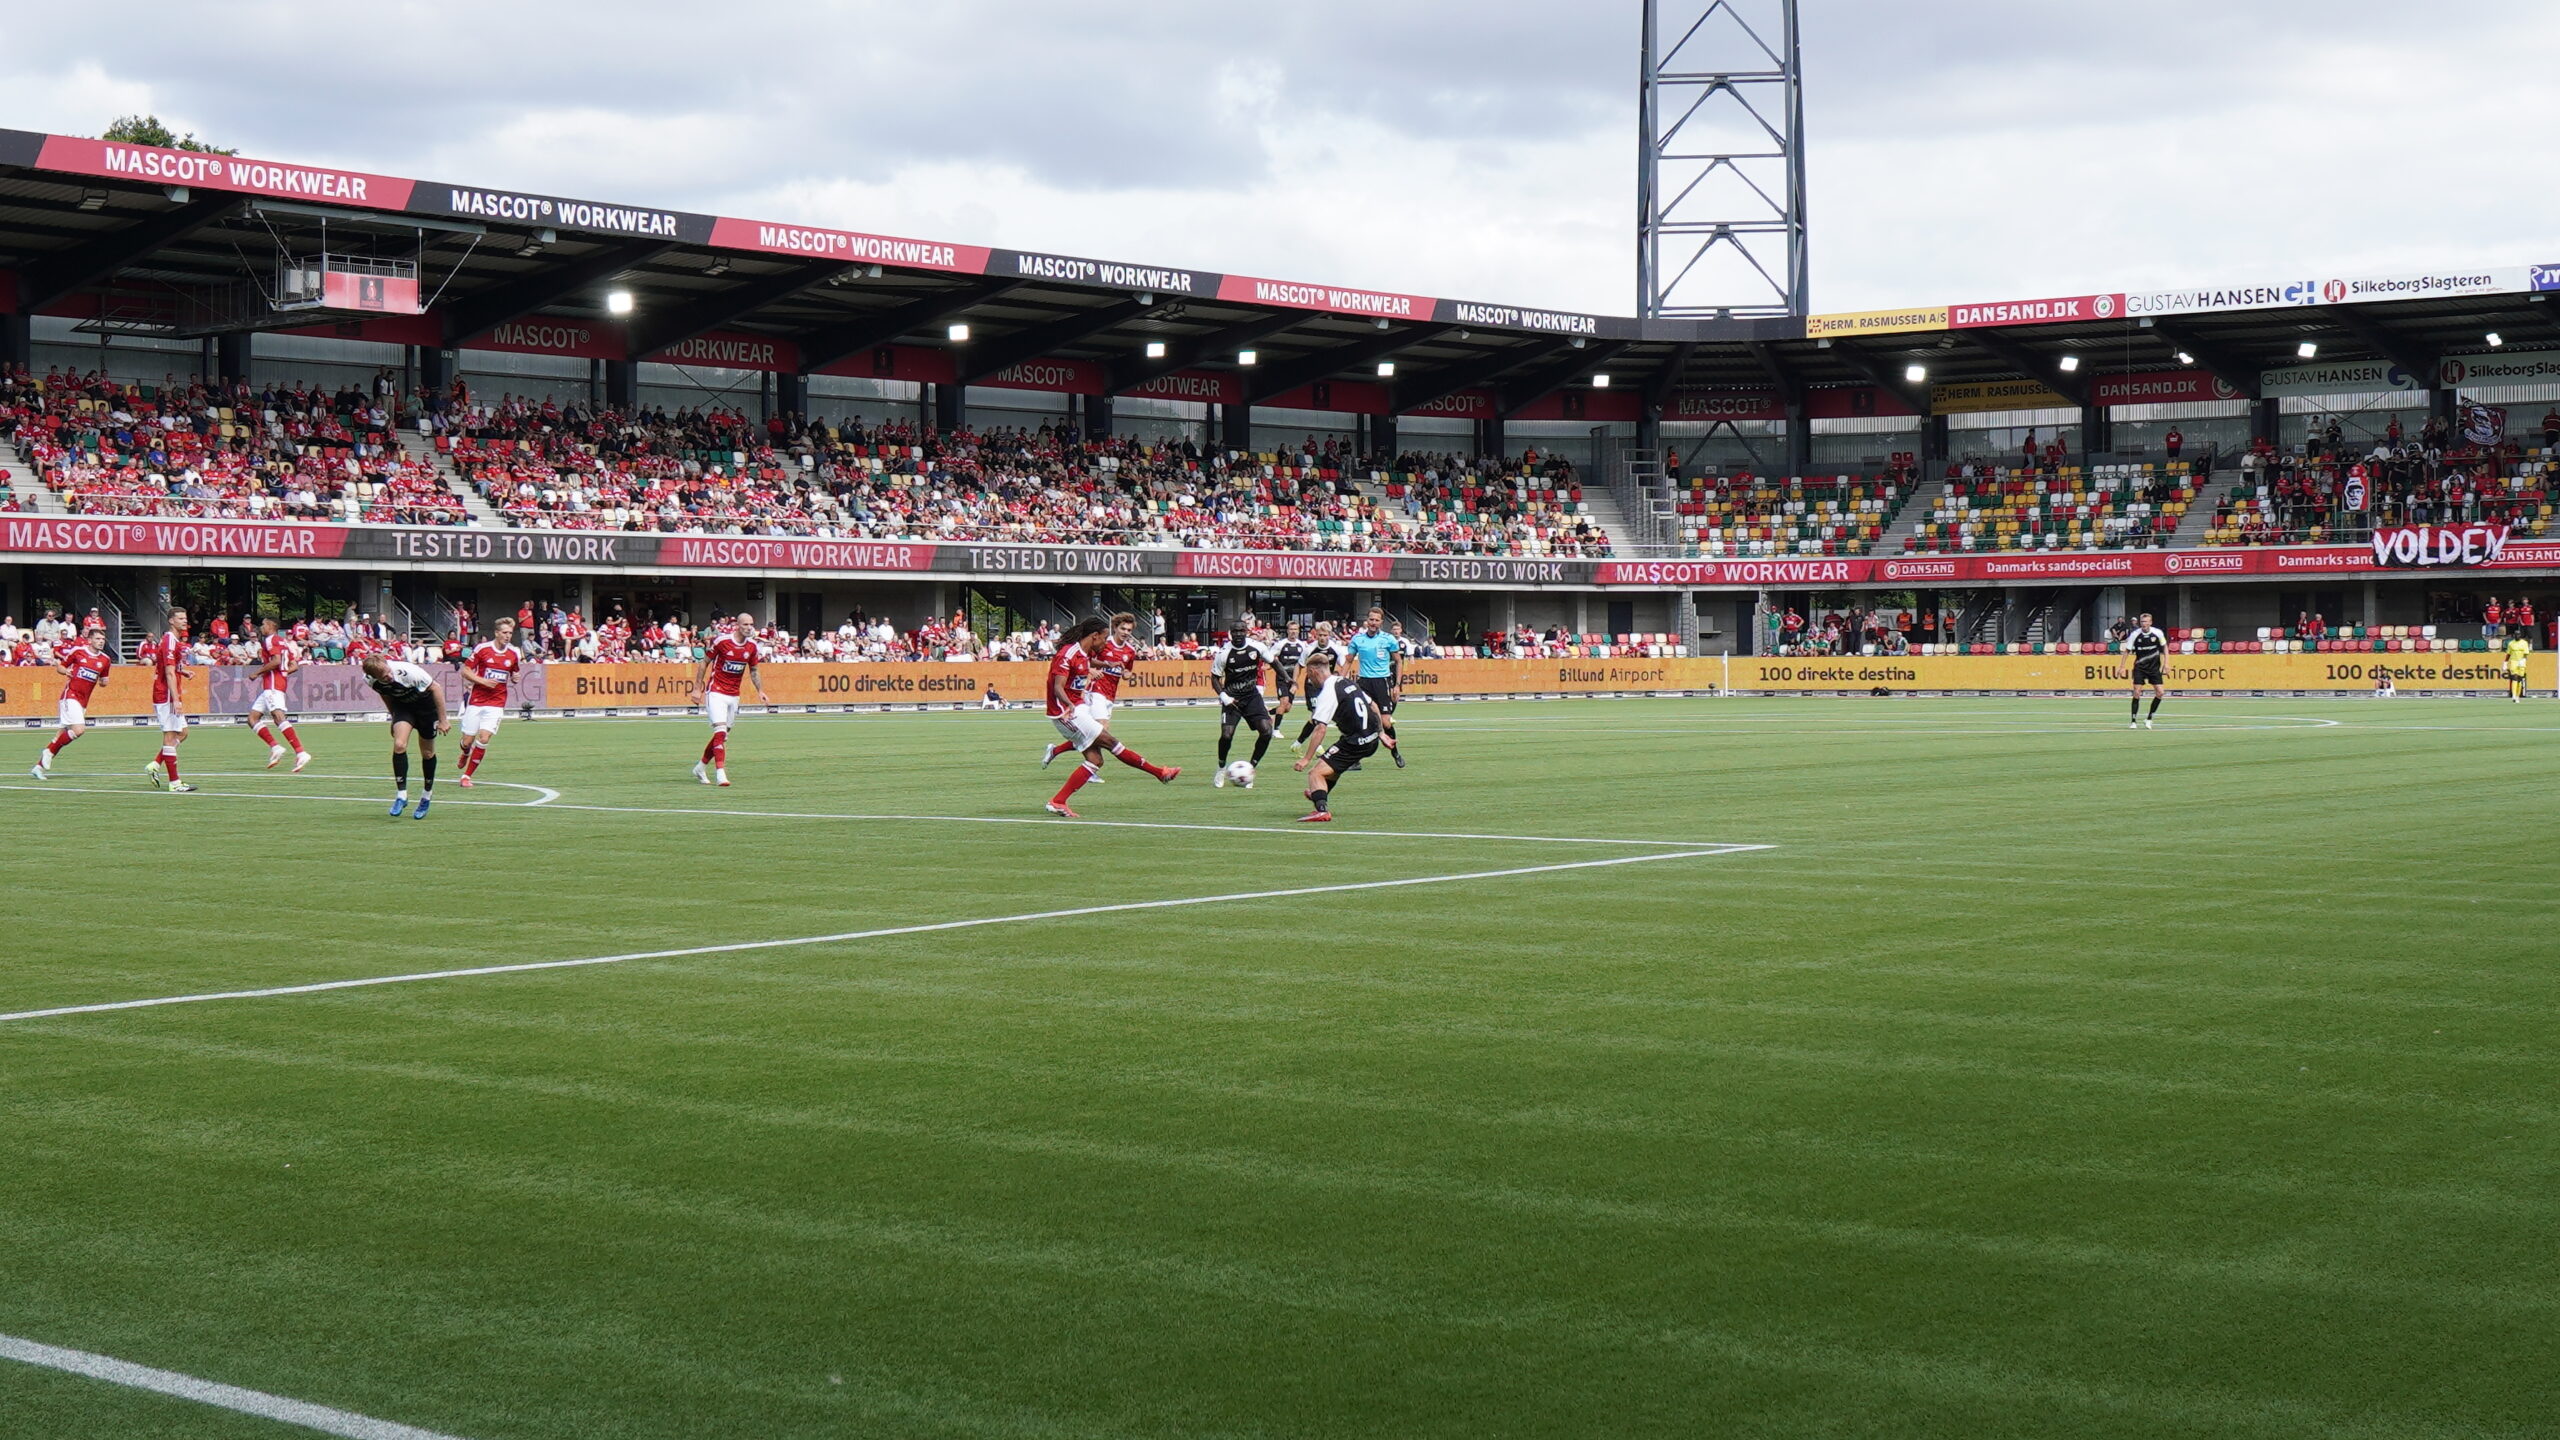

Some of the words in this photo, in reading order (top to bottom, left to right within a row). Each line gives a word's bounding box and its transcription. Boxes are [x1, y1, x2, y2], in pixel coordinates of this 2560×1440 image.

[229, 163, 367, 200] WORKWEAR
[558, 202, 677, 237] WORKWEAR
[852, 236, 955, 267] WORKWEAR
[1099, 263, 1191, 291] WORKWEAR
[2351, 273, 2492, 295] SilkeborgSlagteren
[1329, 290, 1411, 315] WORKWEAR
[2126, 287, 2281, 314] GUSTAVHANSEN
[1521, 311, 1596, 334] WORKWEAR
[1823, 317, 1858, 330] HERM.
[1860, 314, 1926, 328] RASMUSSEN
[1928, 312, 1947, 325] A/S
[1956, 301, 2080, 324] DANSAND.DK
[664, 339, 774, 364] WORKWEAR
[2261, 368, 2382, 387] GUSTAVHANSEN
[1948, 387, 1984, 399] HERM.
[2100, 380, 2198, 397] DANSAND.DK
[155, 525, 316, 555] WORKWEAR
[392, 532, 492, 558] TESTED
[502, 534, 534, 560] TO
[543, 535, 617, 562] WORK
[791, 543, 912, 568] WORKWEAR
[969, 548, 1046, 571] TESTED
[1054, 550, 1077, 571] TO
[1086, 551, 1142, 573] WORK
[1986, 561, 2045, 574] Danmarks
[2048, 558, 2131, 574] sandspecialist
[2184, 556, 2242, 569] DANSAND
[2278, 553, 2341, 568] Danmarks
[2498, 550, 2560, 562] DANSAND
[1278, 557, 1374, 579] WORKWEAR
[1420, 560, 1484, 580] TESTED
[1488, 561, 1506, 580] TO
[1510, 562, 1563, 581] WORK
[1723, 562, 1849, 581] WORKWEAR
[1901, 563, 1955, 575] DANSAND
[818, 674, 850, 692] 100
[854, 674, 914, 692] direkte
[918, 673, 975, 692] destina
[1130, 672, 1183, 688] Billund
[1401, 670, 1438, 686] estina
[1559, 669, 1604, 683] Billund
[1609, 669, 1664, 686] Airport
[1759, 667, 1792, 681] 100
[1797, 666, 1854, 681] direkte
[1859, 666, 1915, 681] destina
[2326, 665, 2361, 680] 100
[2368, 664, 2436, 679] direkte
[2441, 664, 2512, 680] destina
[308, 677, 365, 708] park
[577, 677, 649, 694] Billund
[1354, 697, 1369, 730] 9
